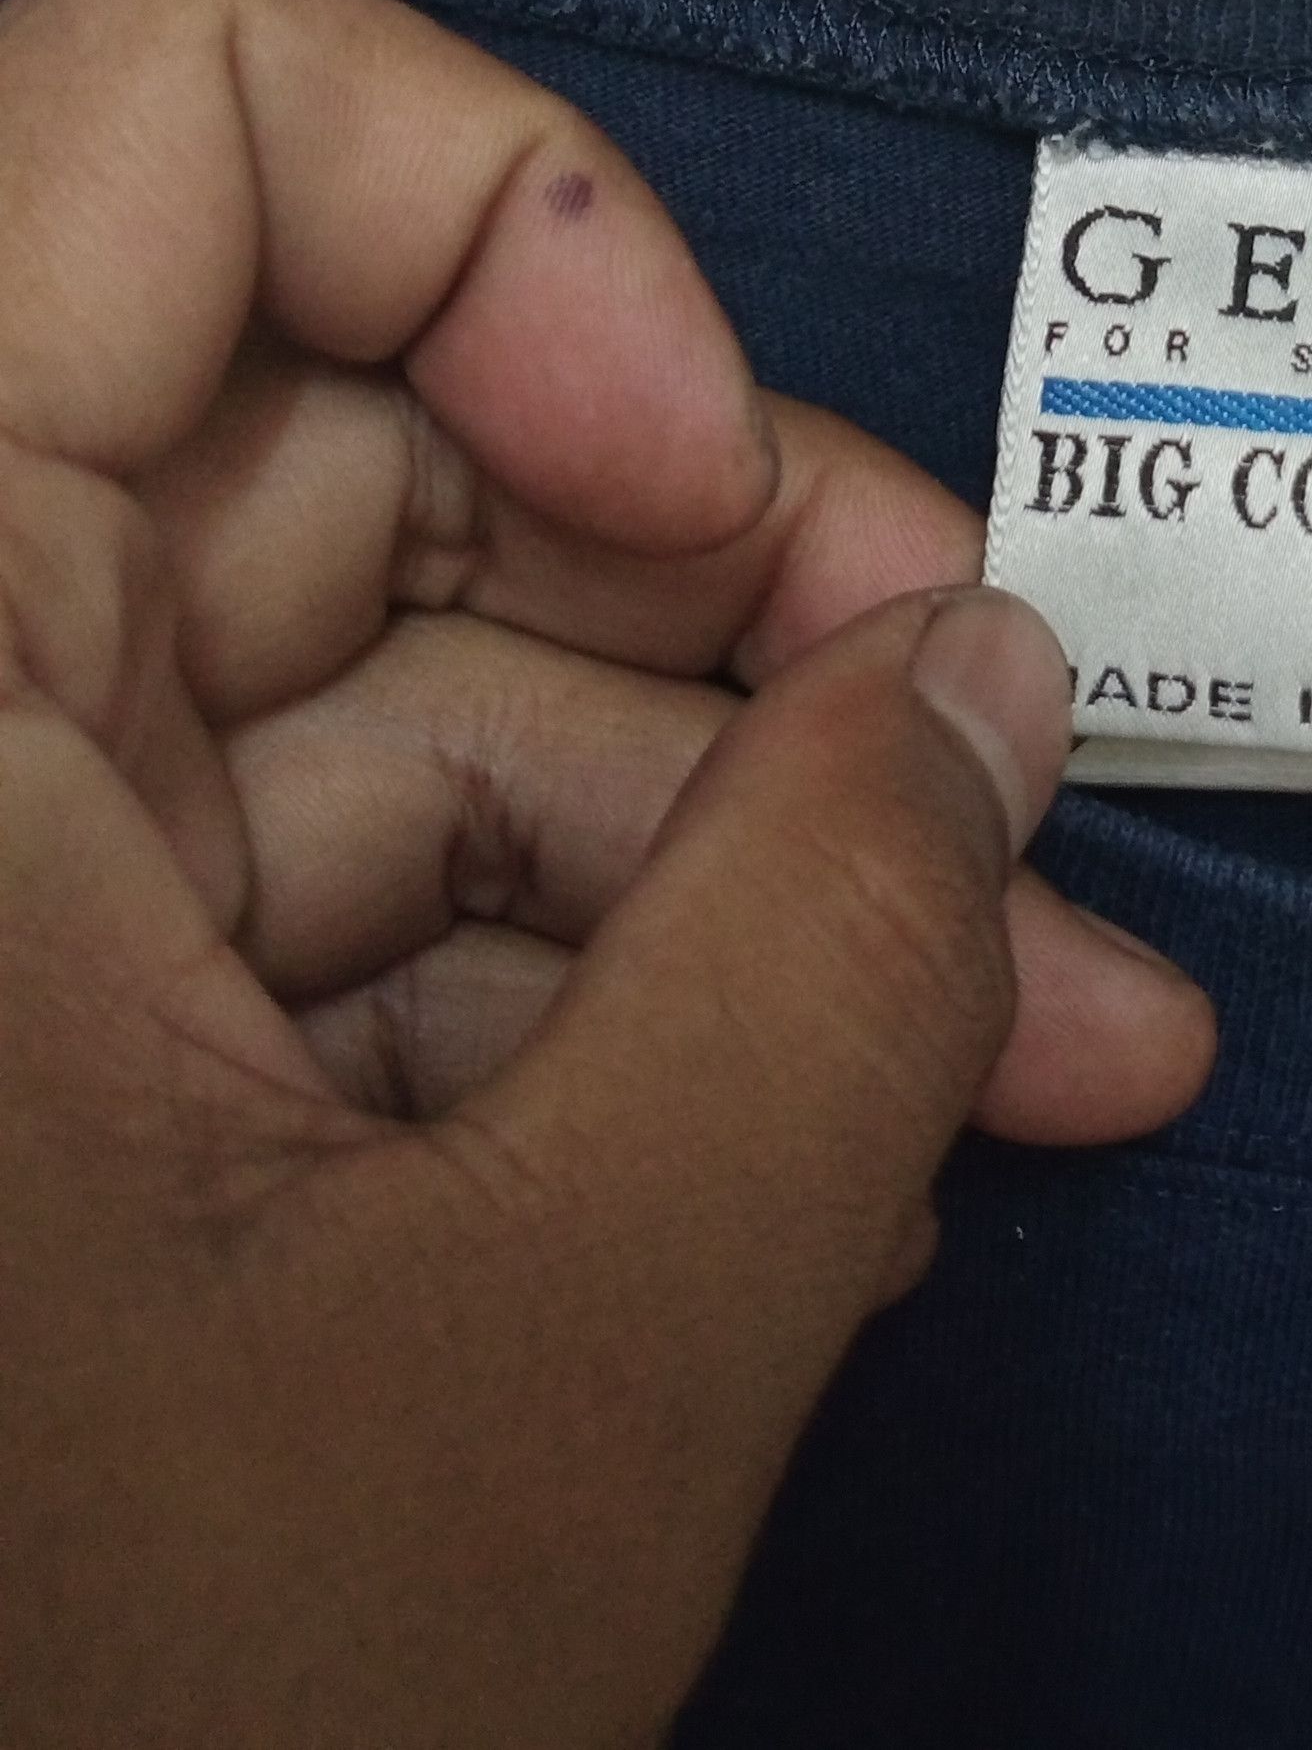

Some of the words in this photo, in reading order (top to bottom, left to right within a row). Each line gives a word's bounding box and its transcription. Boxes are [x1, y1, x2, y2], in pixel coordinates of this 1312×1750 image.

[1043, 320, 1191, 363] FOR
[1023, 428, 1201, 523] BIG
[1071, 665, 1255, 723] ADE
